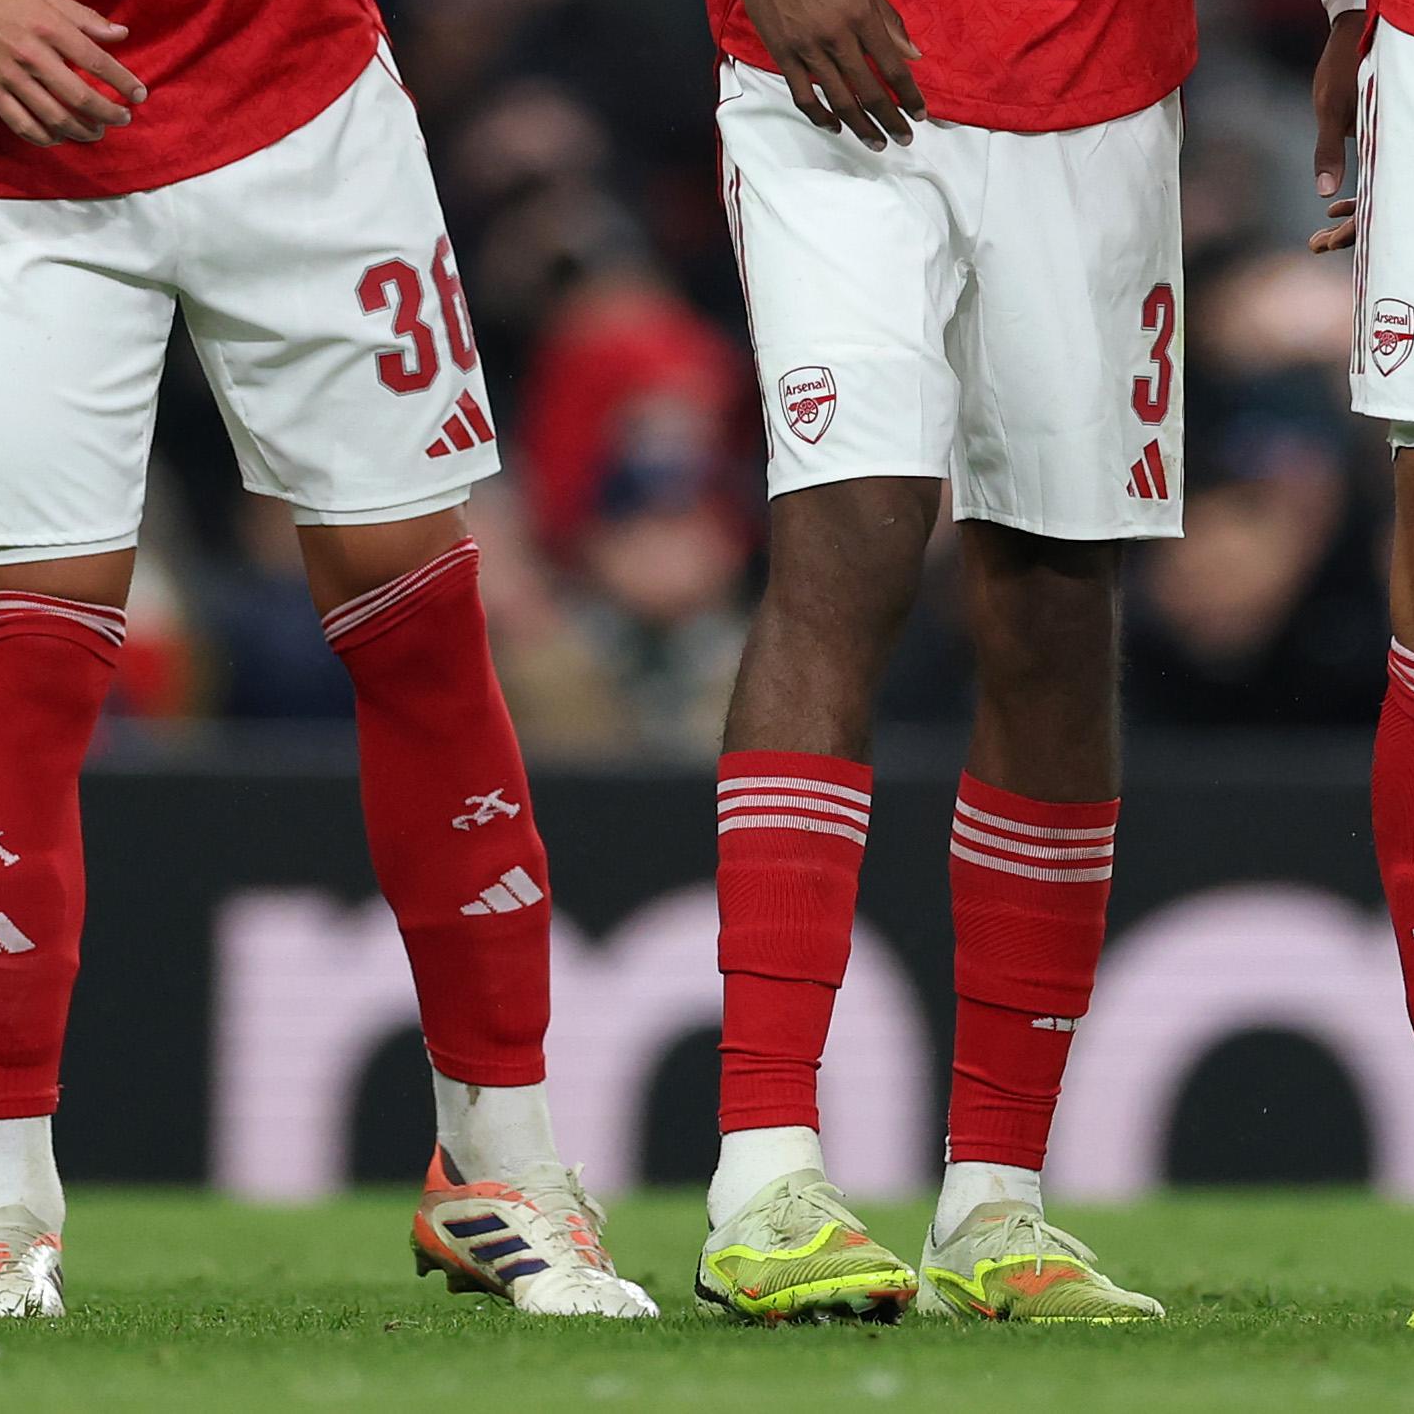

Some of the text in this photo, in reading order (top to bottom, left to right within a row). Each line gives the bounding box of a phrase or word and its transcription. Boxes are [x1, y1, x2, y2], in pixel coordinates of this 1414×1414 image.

[354, 233, 477, 397] 36
[1131, 283, 1175, 426] 3
[785, 377, 826, 397] Arsenal
